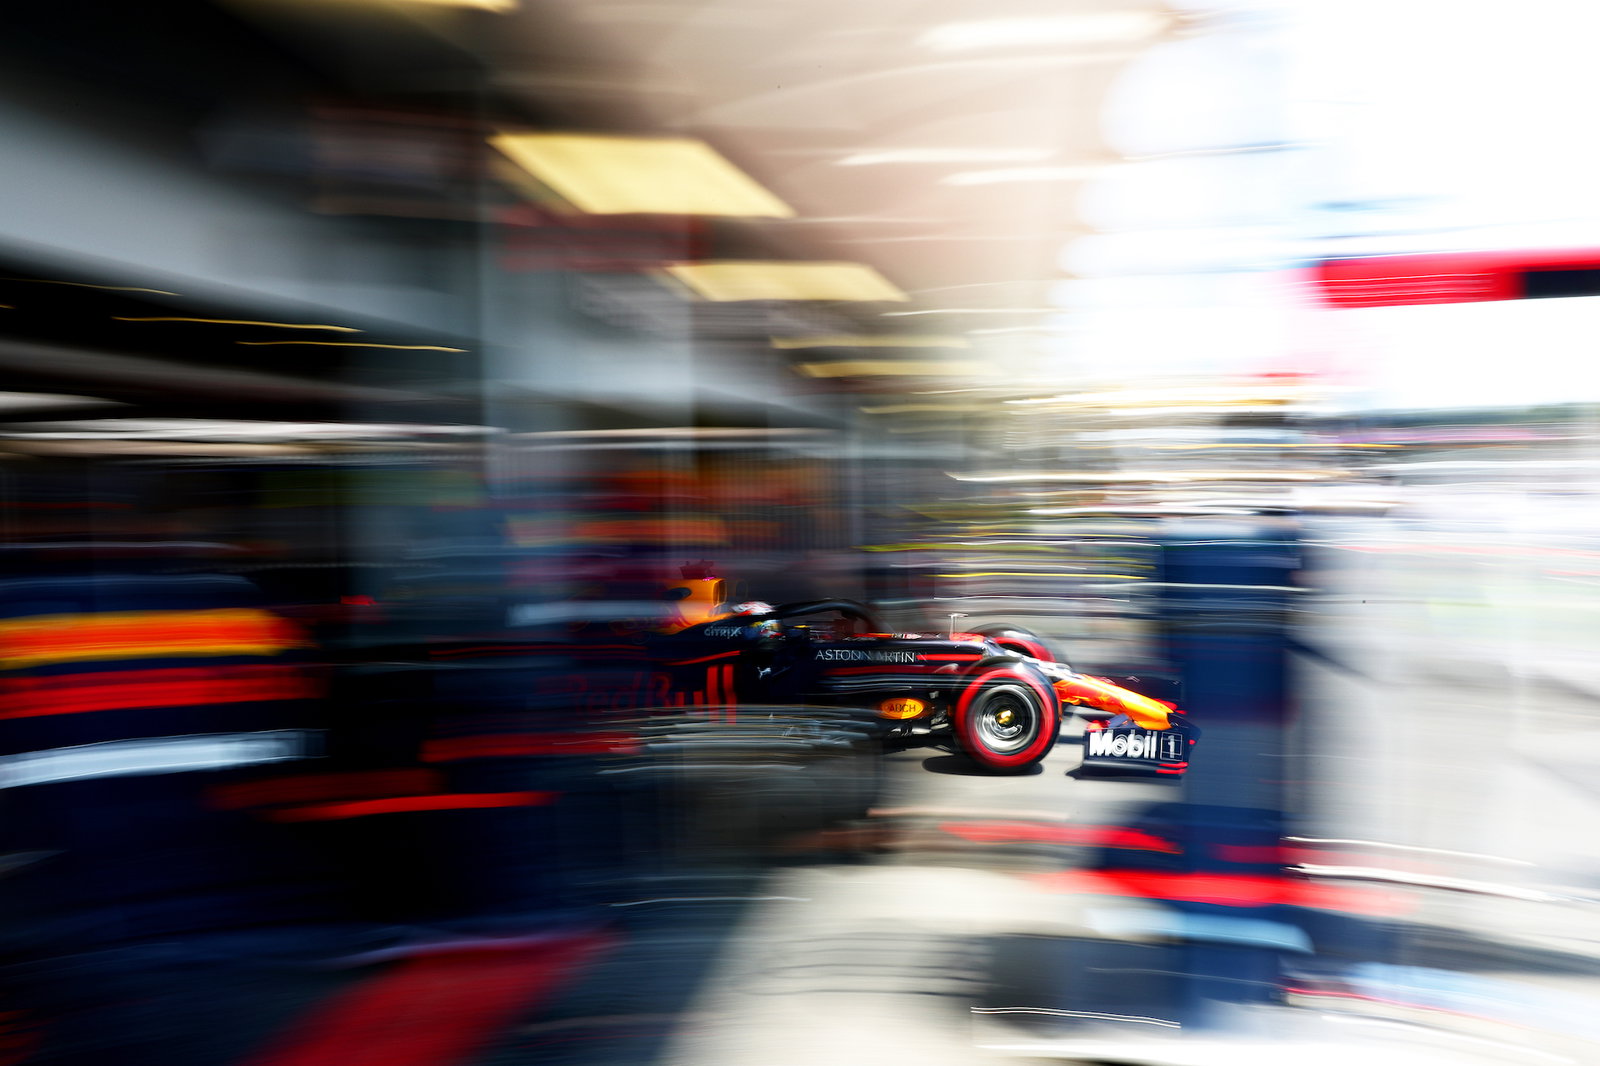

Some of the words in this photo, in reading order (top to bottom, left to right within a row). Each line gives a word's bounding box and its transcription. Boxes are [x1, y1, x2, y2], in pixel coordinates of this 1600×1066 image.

[816, 649, 868, 661] ASTON
[871, 649, 915, 662] ARTIN
[1089, 730, 1157, 759] Mobil
[1167, 735, 1175, 759] 1
